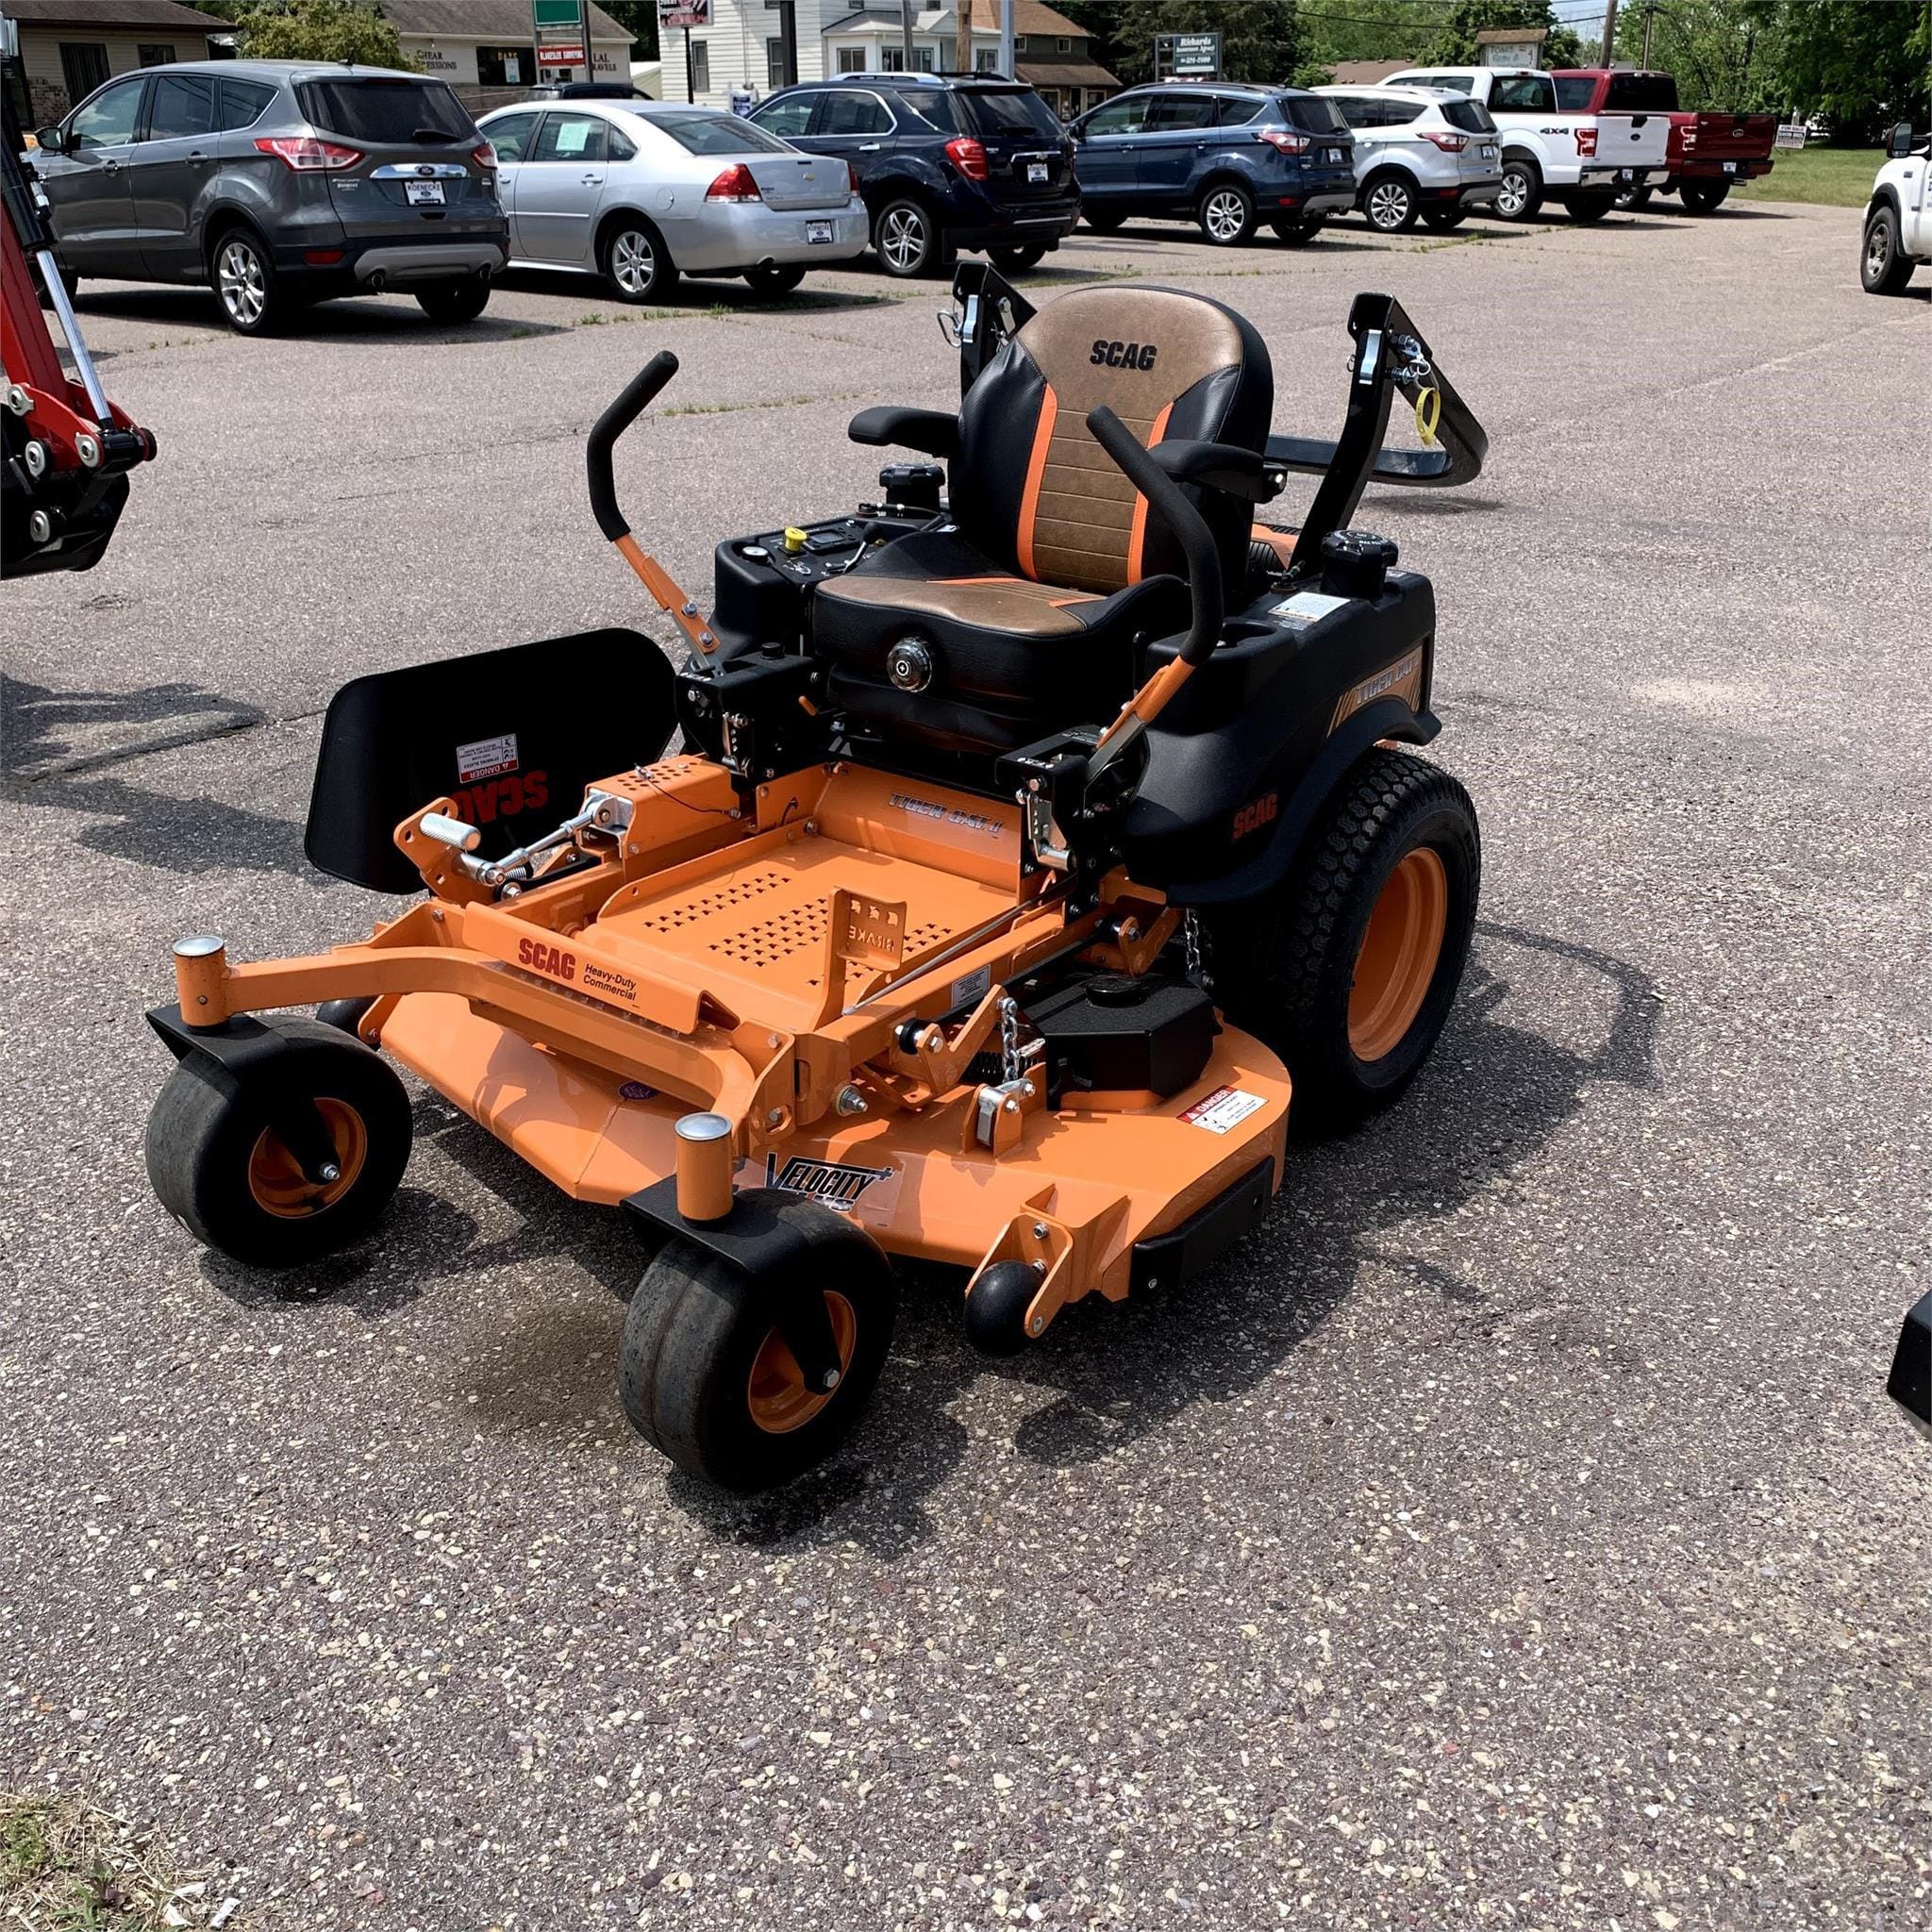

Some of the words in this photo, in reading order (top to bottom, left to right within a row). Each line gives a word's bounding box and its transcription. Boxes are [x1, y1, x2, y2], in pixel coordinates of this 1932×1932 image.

[591, 63, 617, 72] RAVELS
[408, 183, 441, 192] KOENECKE
[1090, 340, 1158, 372] SCAG
[470, 765, 500, 779] DANGER
[889, 792, 947, 819] TIGER
[1232, 793, 1277, 840] SCAG
[518, 938, 576, 981] SCAG
[583, 974, 637, 1001] Commercial
[585, 963, 637, 991] Heavy-Duty
[1195, 1090, 1231, 1112] DANGER
